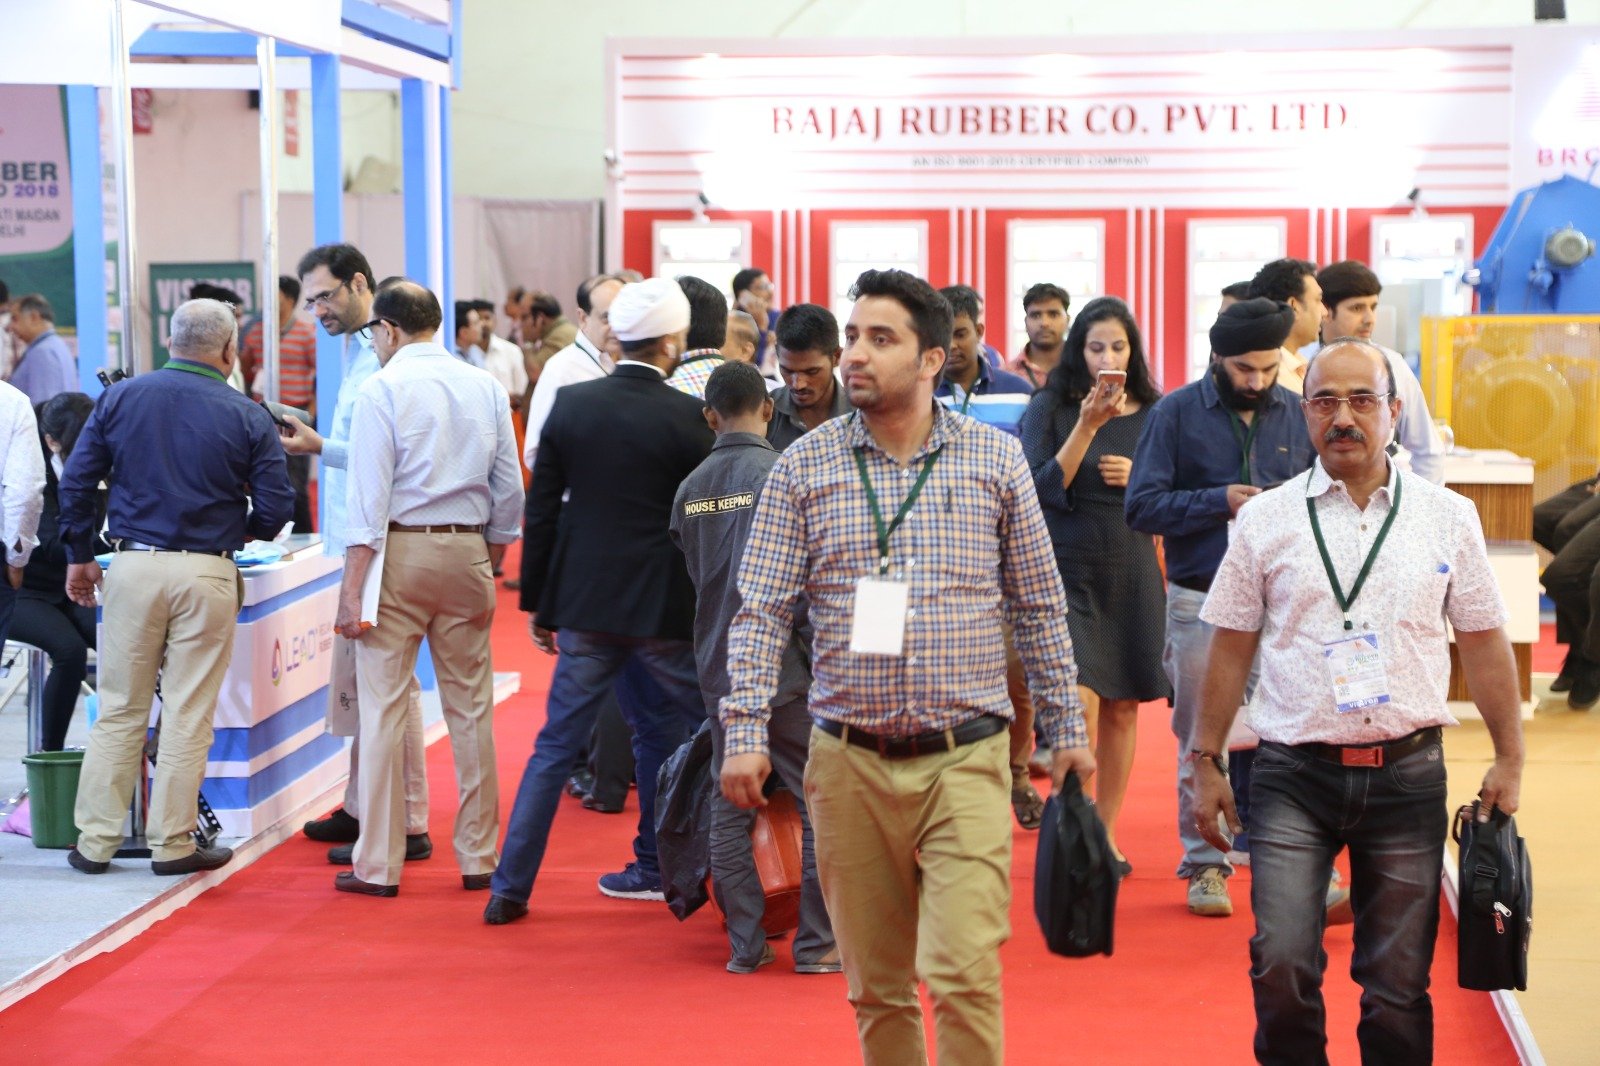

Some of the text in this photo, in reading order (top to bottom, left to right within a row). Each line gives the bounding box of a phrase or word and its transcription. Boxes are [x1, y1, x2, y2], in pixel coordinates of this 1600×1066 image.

[773, 106, 883, 141] BAJAJ
[900, 105, 1069, 136] RUBBER
[1085, 103, 1149, 135] CO.
[1164, 103, 1254, 133] PVT.
[933, 155, 955, 167] ISO
[1088, 154, 1150, 167] COMPANY
[14, 183, 59, 197] 2018
[686, 500, 716, 516] HOUSE
